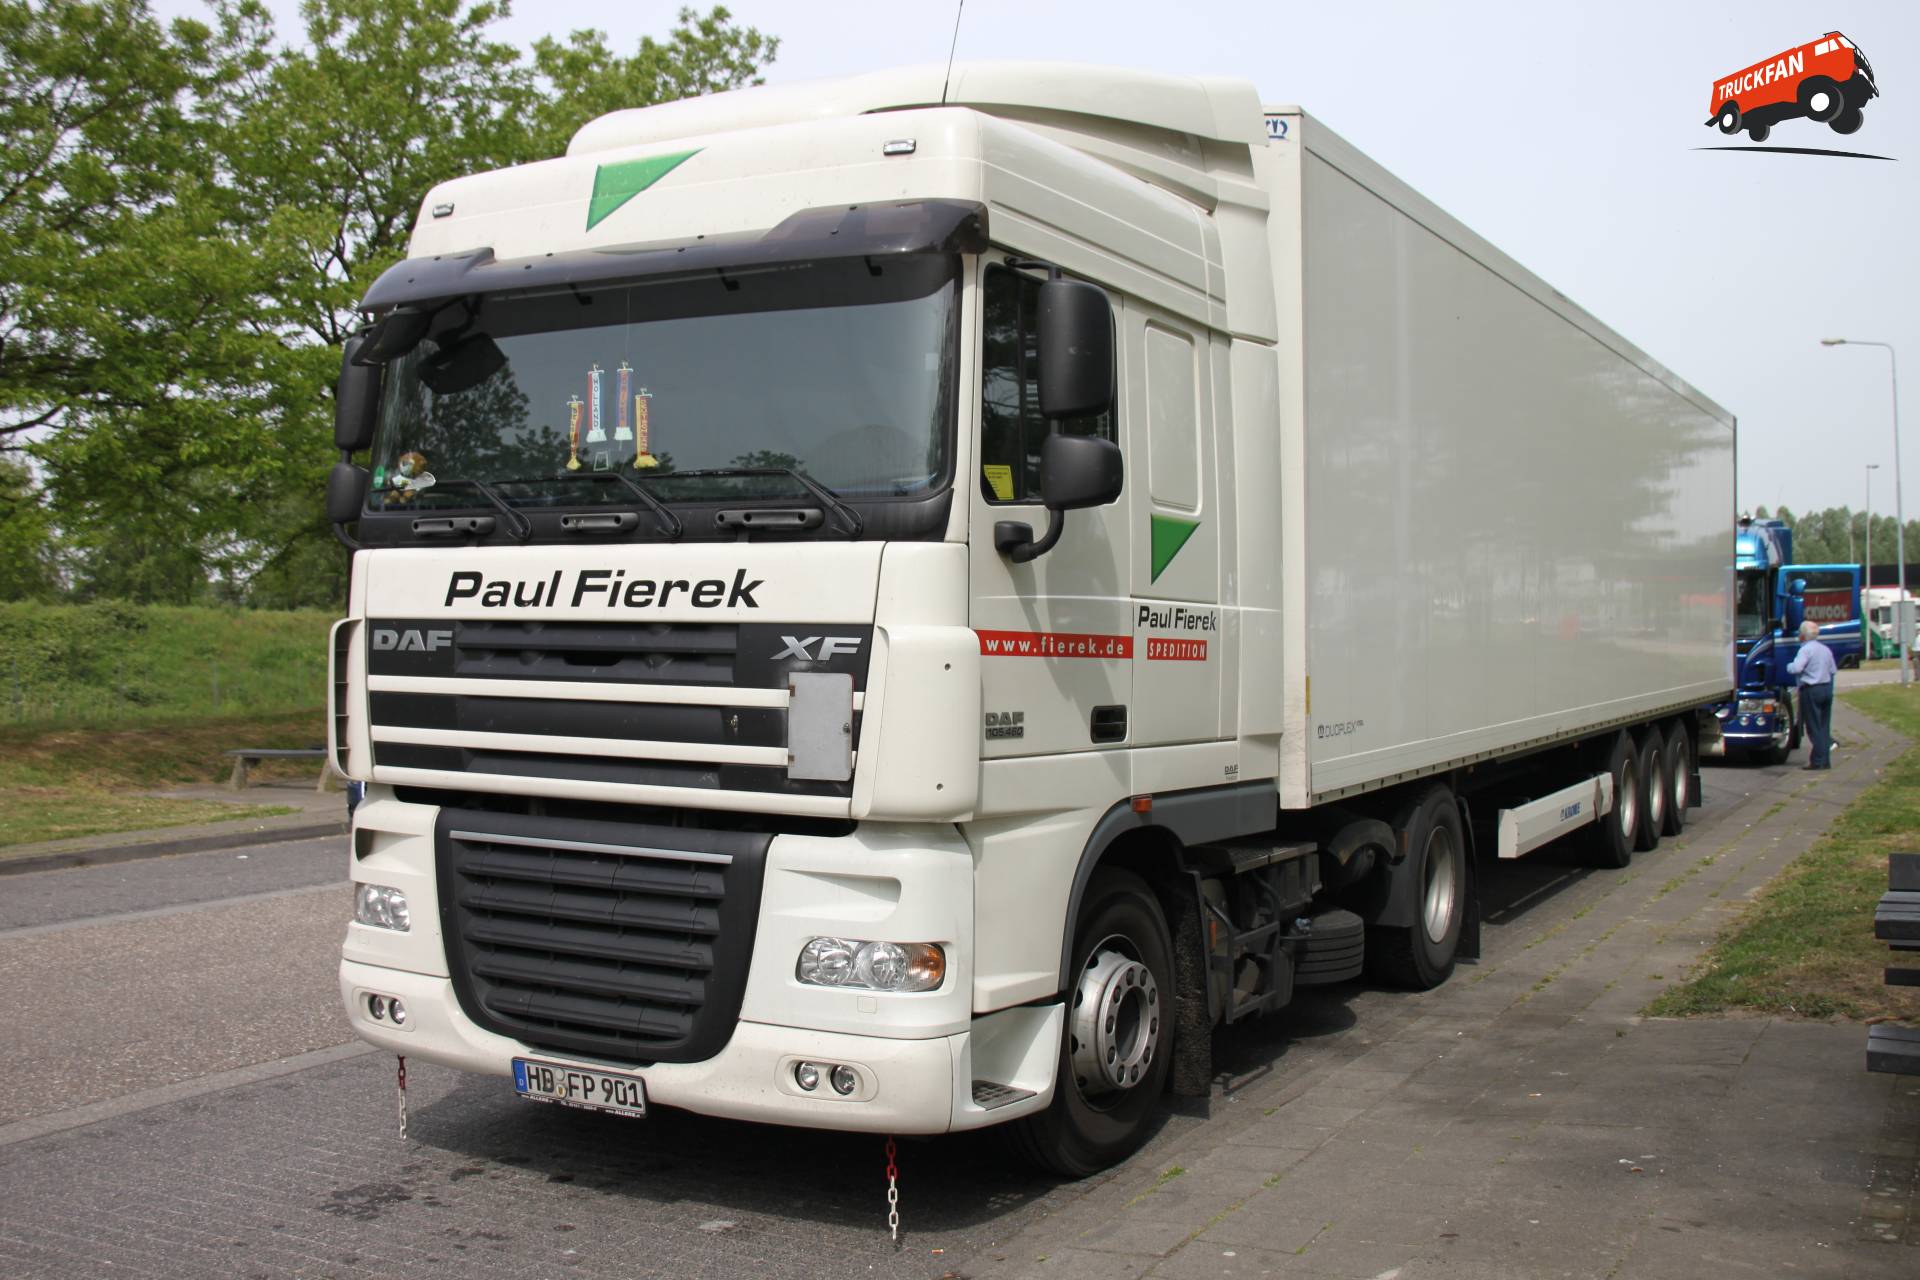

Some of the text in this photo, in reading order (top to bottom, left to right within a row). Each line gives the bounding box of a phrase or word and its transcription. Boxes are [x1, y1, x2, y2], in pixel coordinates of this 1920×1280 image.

[445, 568, 765, 609] Paul Fierek
[1138, 605, 1217, 631] Paul Fierek
[373, 629, 452, 652] DAF
[770, 635, 862, 661] XF
[986, 636, 1124, 654] www.fierek.de
[1149, 642, 1206, 659] SPEDITION
[985, 711, 1024, 726] DAF
[567, 1072, 596, 1100] FP
[601, 1078, 643, 1109] 901
